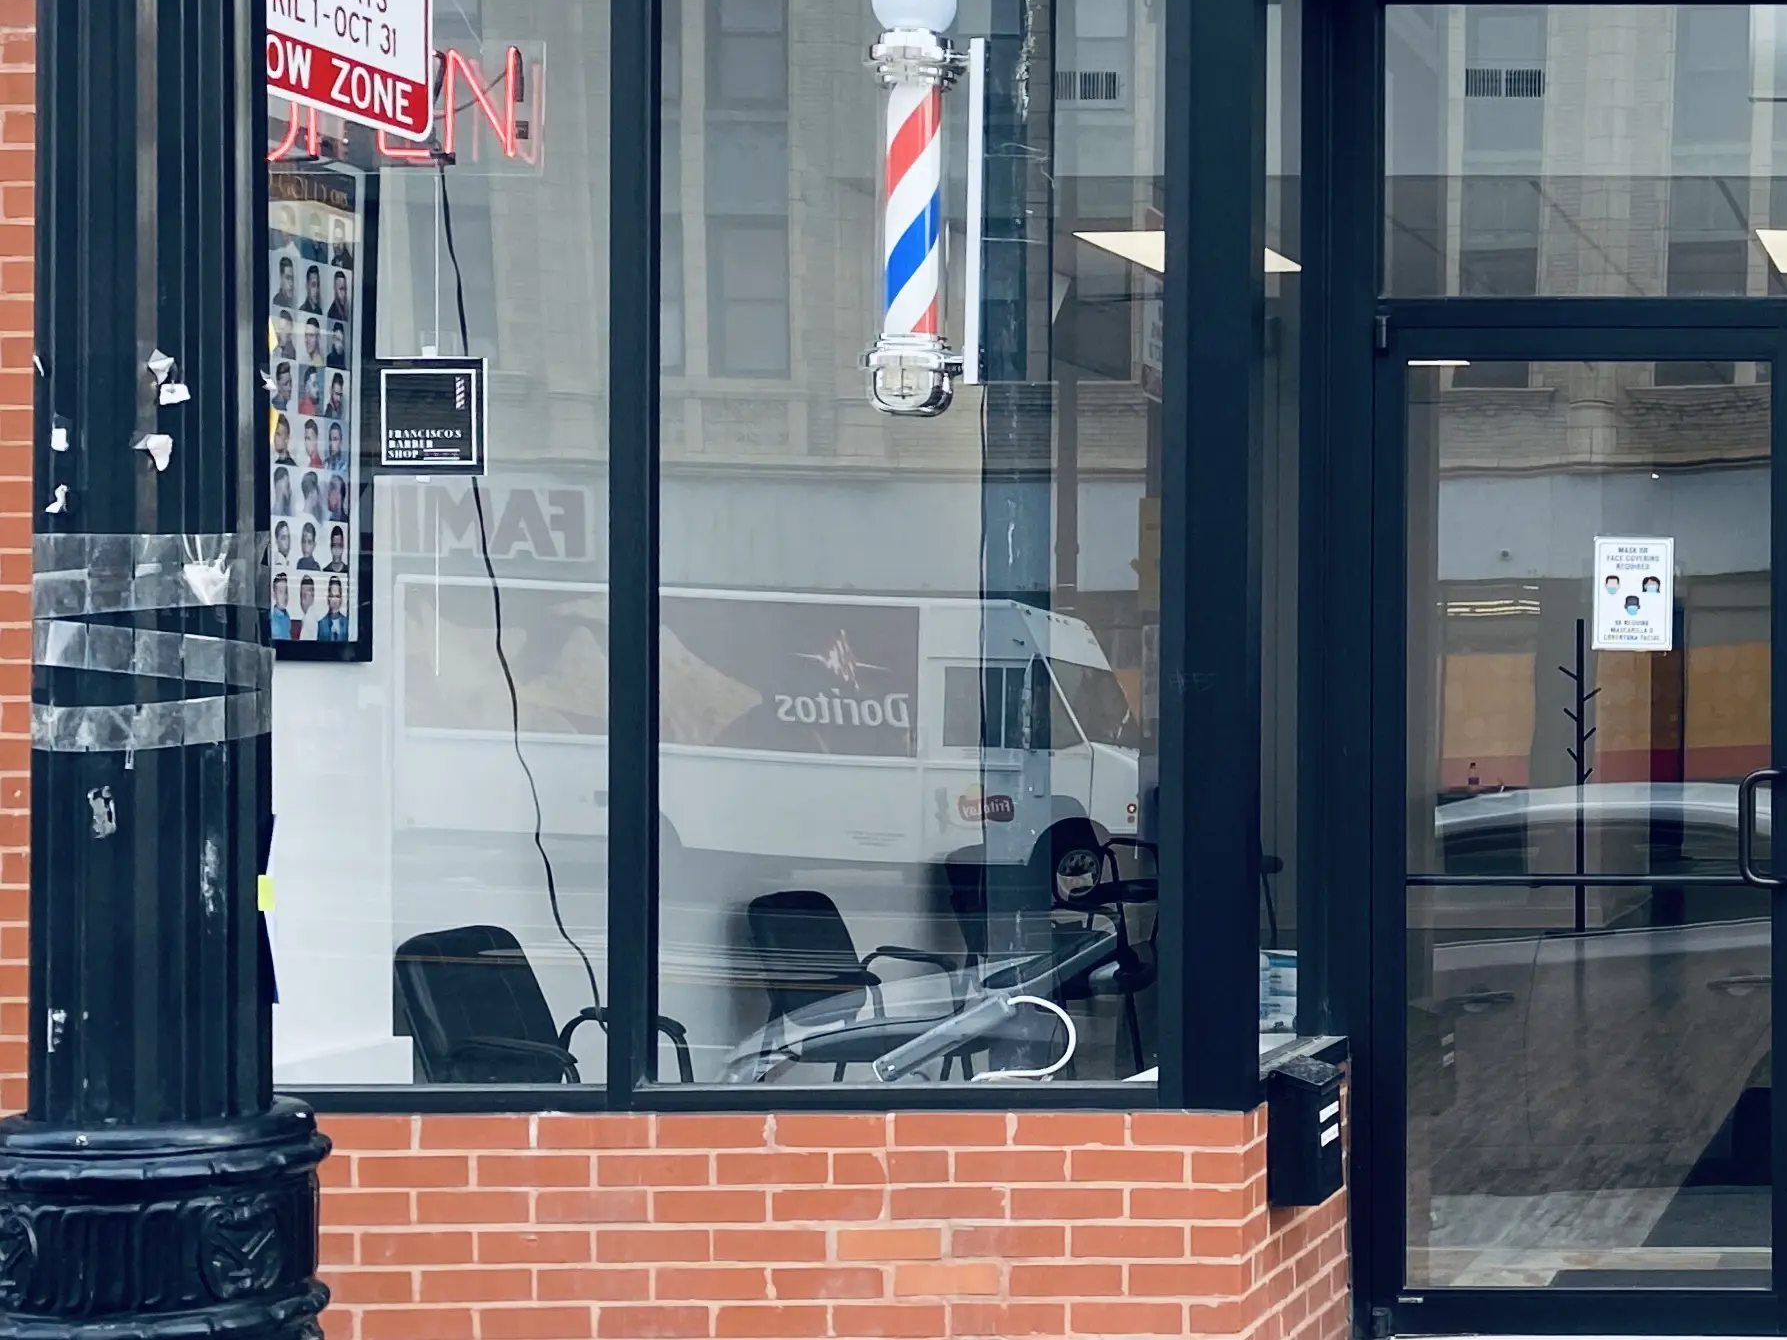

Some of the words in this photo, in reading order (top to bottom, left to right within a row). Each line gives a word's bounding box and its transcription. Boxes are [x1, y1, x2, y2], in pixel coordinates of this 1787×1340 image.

[380, 23, 397, 57] 31
[266, 34, 312, 90] OW
[330, 58, 414, 125] ZONE
[387, 449, 419, 459] SHOP
[388, 439, 434, 449] BARBER
